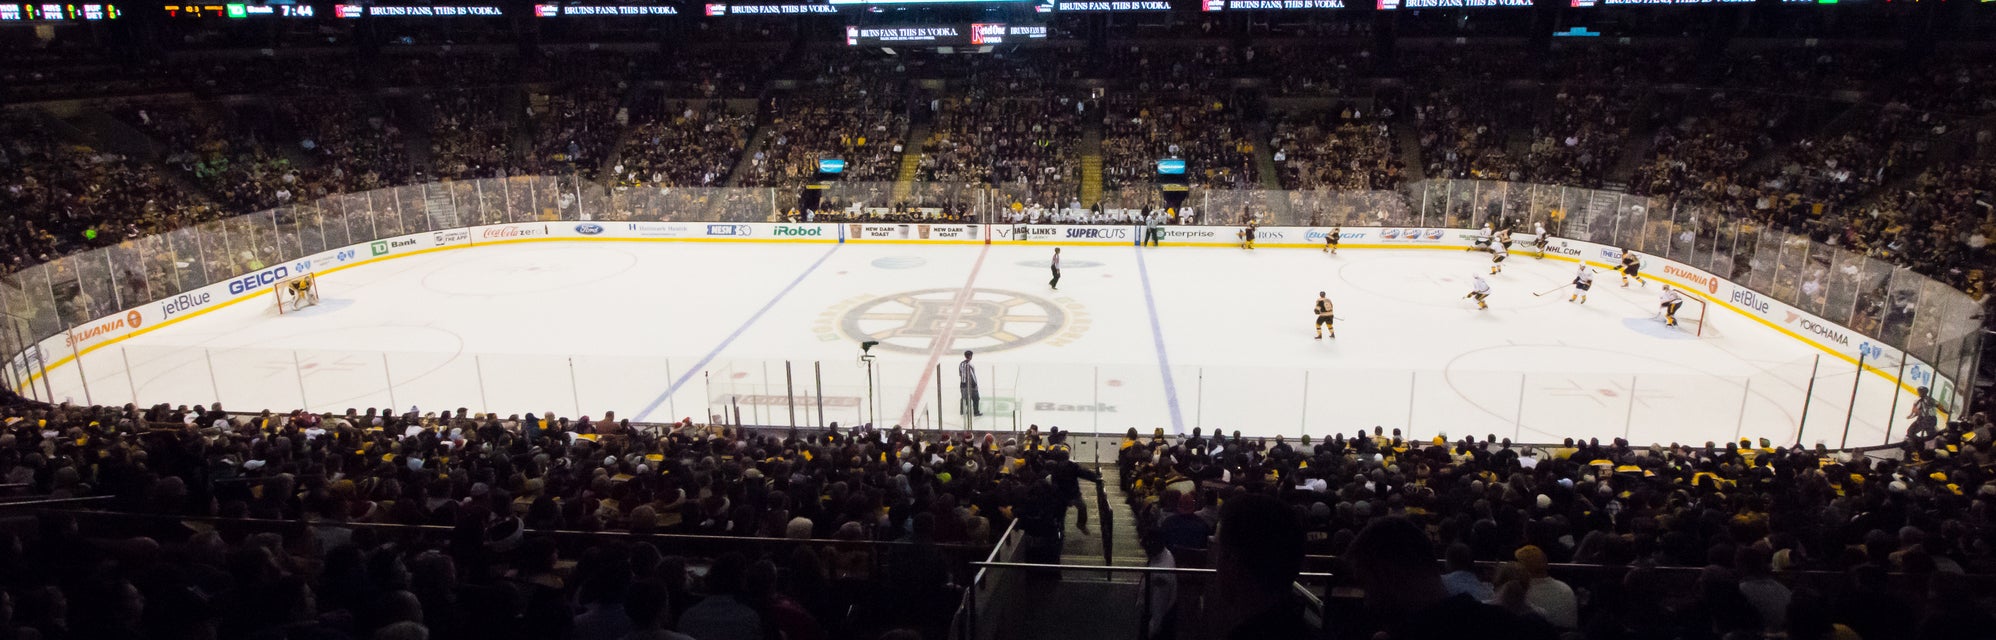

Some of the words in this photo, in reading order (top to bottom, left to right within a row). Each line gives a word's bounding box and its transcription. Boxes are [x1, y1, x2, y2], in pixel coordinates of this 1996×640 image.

[732, 5, 758, 13] BRUINS
[781, 5, 799, 13] THIS
[800, 5, 807, 13] IS
[1060, 2, 1089, 10] BRUINS
[1112, 2, 1131, 10] THIS
[1132, 2, 1139, 10] IS
[1230, 0, 1259, 8] BRUINS
[1284, 0, 1304, 8] THIS
[1305, 0, 1312, 8] IS
[282, 6, 312, 16] 7:44
[370, 7, 405, 15] BRUINS
[407, 7, 432, 15] FANS,
[434, 7, 456, 15] THIS
[457, 7, 466, 15] IS
[468, 7, 502, 15] VODKA.
[565, 6, 594, 14] BRUINS
[596, 6, 618, 14] FANS,
[619, 6, 639, 14] THIS
[640, 6, 648, 14] IS
[649, 6, 677, 14] VODKA.
[918, 28, 926, 36] IS
[927, 28, 958, 36] VODKA.
[580, 225, 598, 233] Ford
[774, 226, 821, 236] iRobot
[1032, 227, 1056, 235] LINK'S
[1066, 228, 1126, 238] SUPERCUTS
[391, 238, 416, 248] Bank
[1546, 245, 1581, 256] NHL.COM
[229, 266, 288, 295] GEICO
[1664, 265, 1707, 286] SYLVANIA
[1730, 286, 1769, 313] jetBlue
[161, 292, 210, 320] jetBlue
[66, 319, 124, 347] SYLVANIA
[1800, 317, 1848, 346] YOKOHAMA
[1035, 402, 1118, 412] Bank
